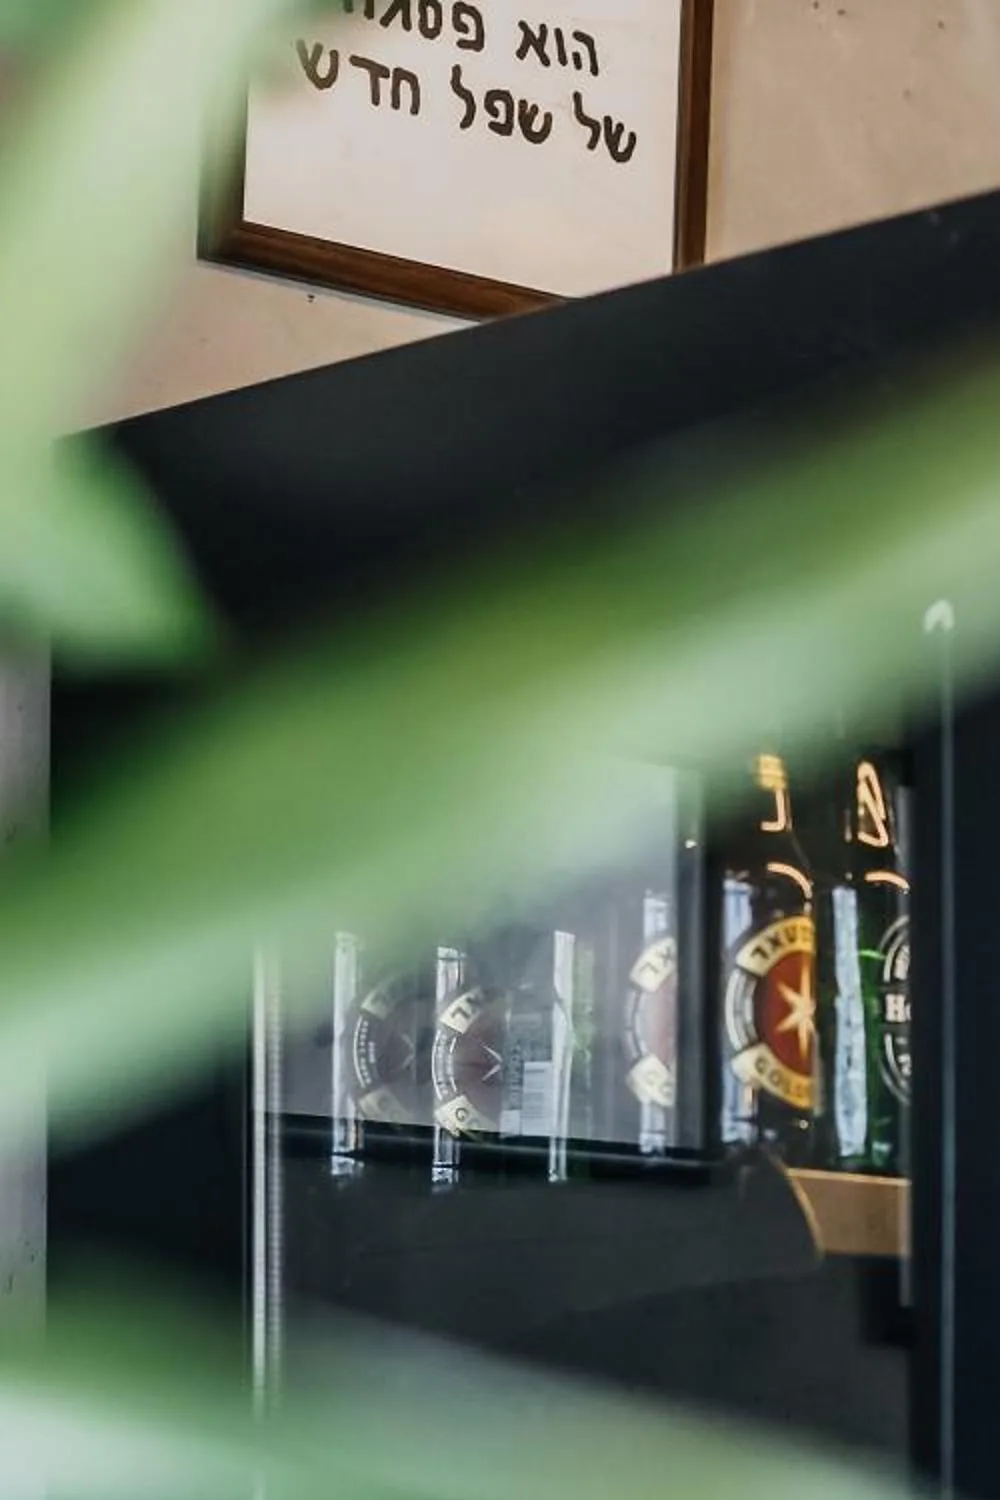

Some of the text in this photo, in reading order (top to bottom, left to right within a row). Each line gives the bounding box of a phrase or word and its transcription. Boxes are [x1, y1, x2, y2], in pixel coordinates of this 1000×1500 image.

[515, 20, 600, 76] הוא
[297, 38, 637, 163] של שפל חדש
